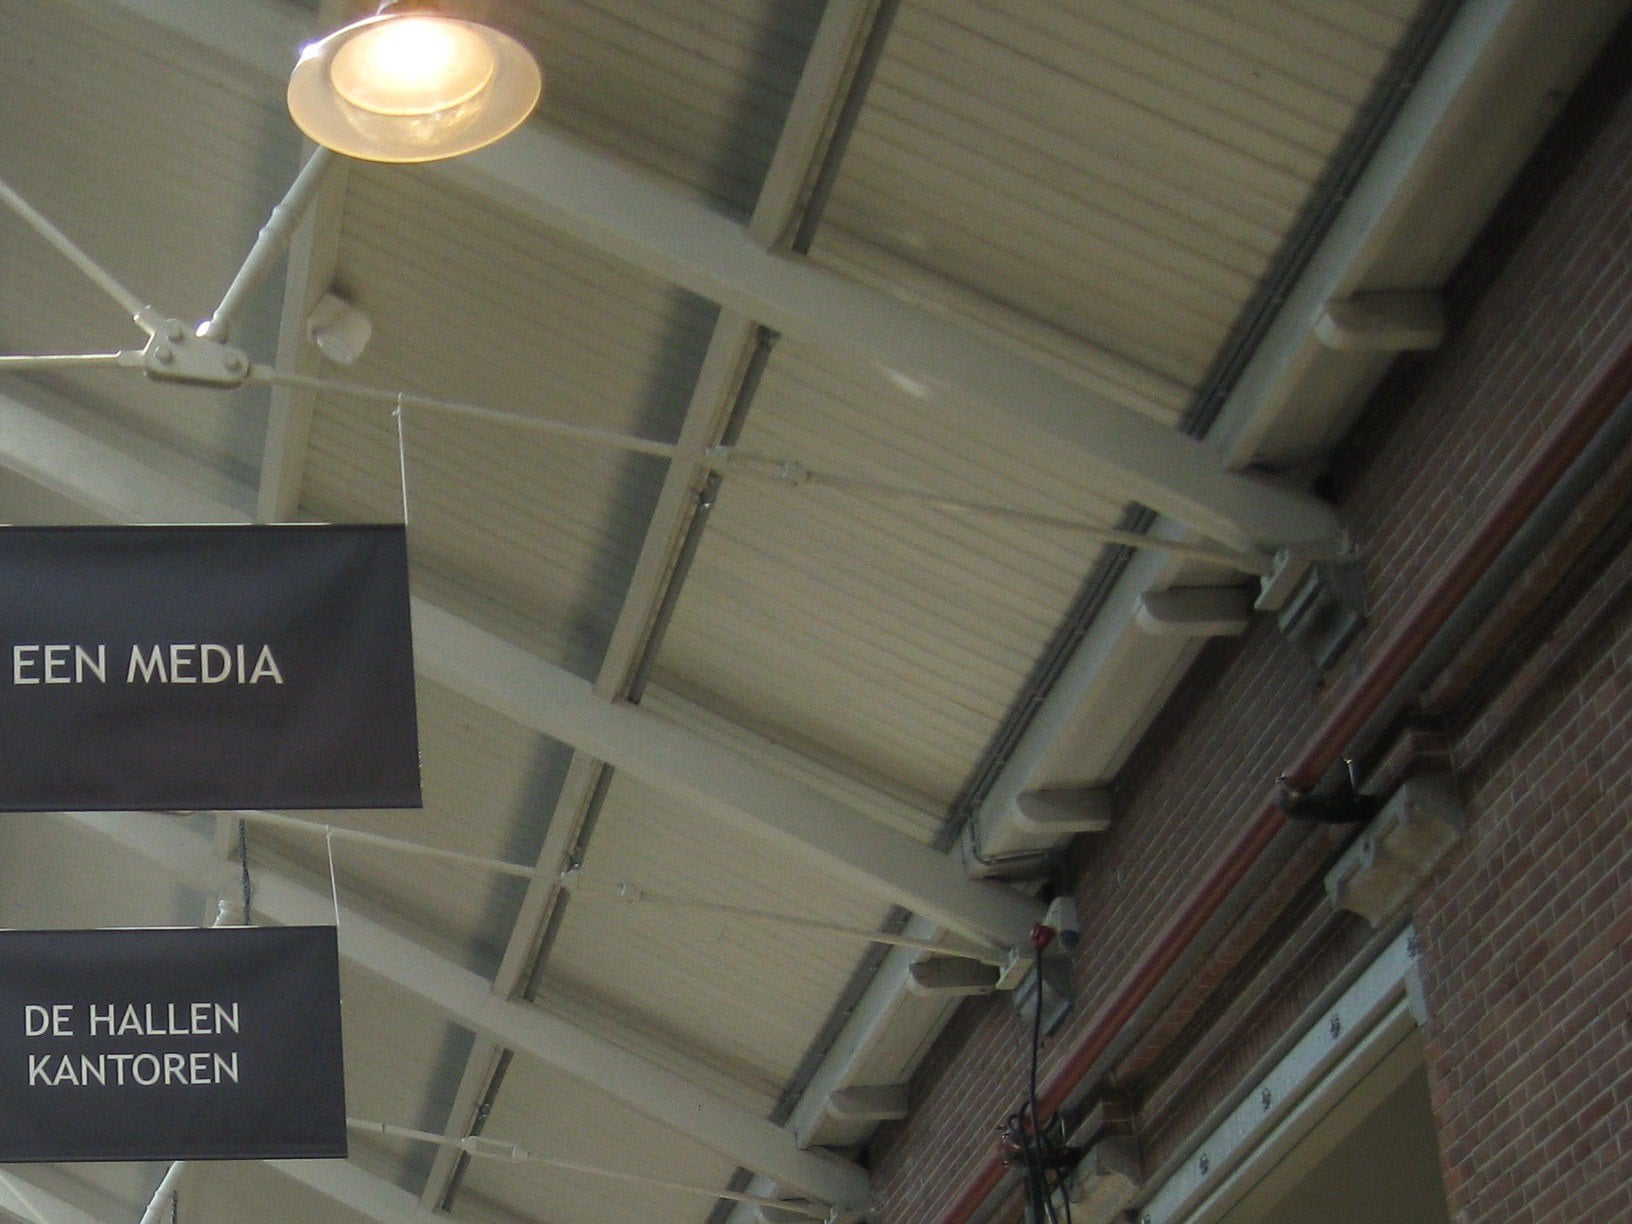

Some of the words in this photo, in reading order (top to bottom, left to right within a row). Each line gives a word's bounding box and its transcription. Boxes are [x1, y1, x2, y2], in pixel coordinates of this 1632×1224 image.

[13, 644, 106, 685] EEN
[126, 643, 284, 684] MEDIA
[25, 1004, 74, 1037] DE
[89, 1002, 239, 1036] HALLEN
[28, 1052, 239, 1086] KANTOREN
